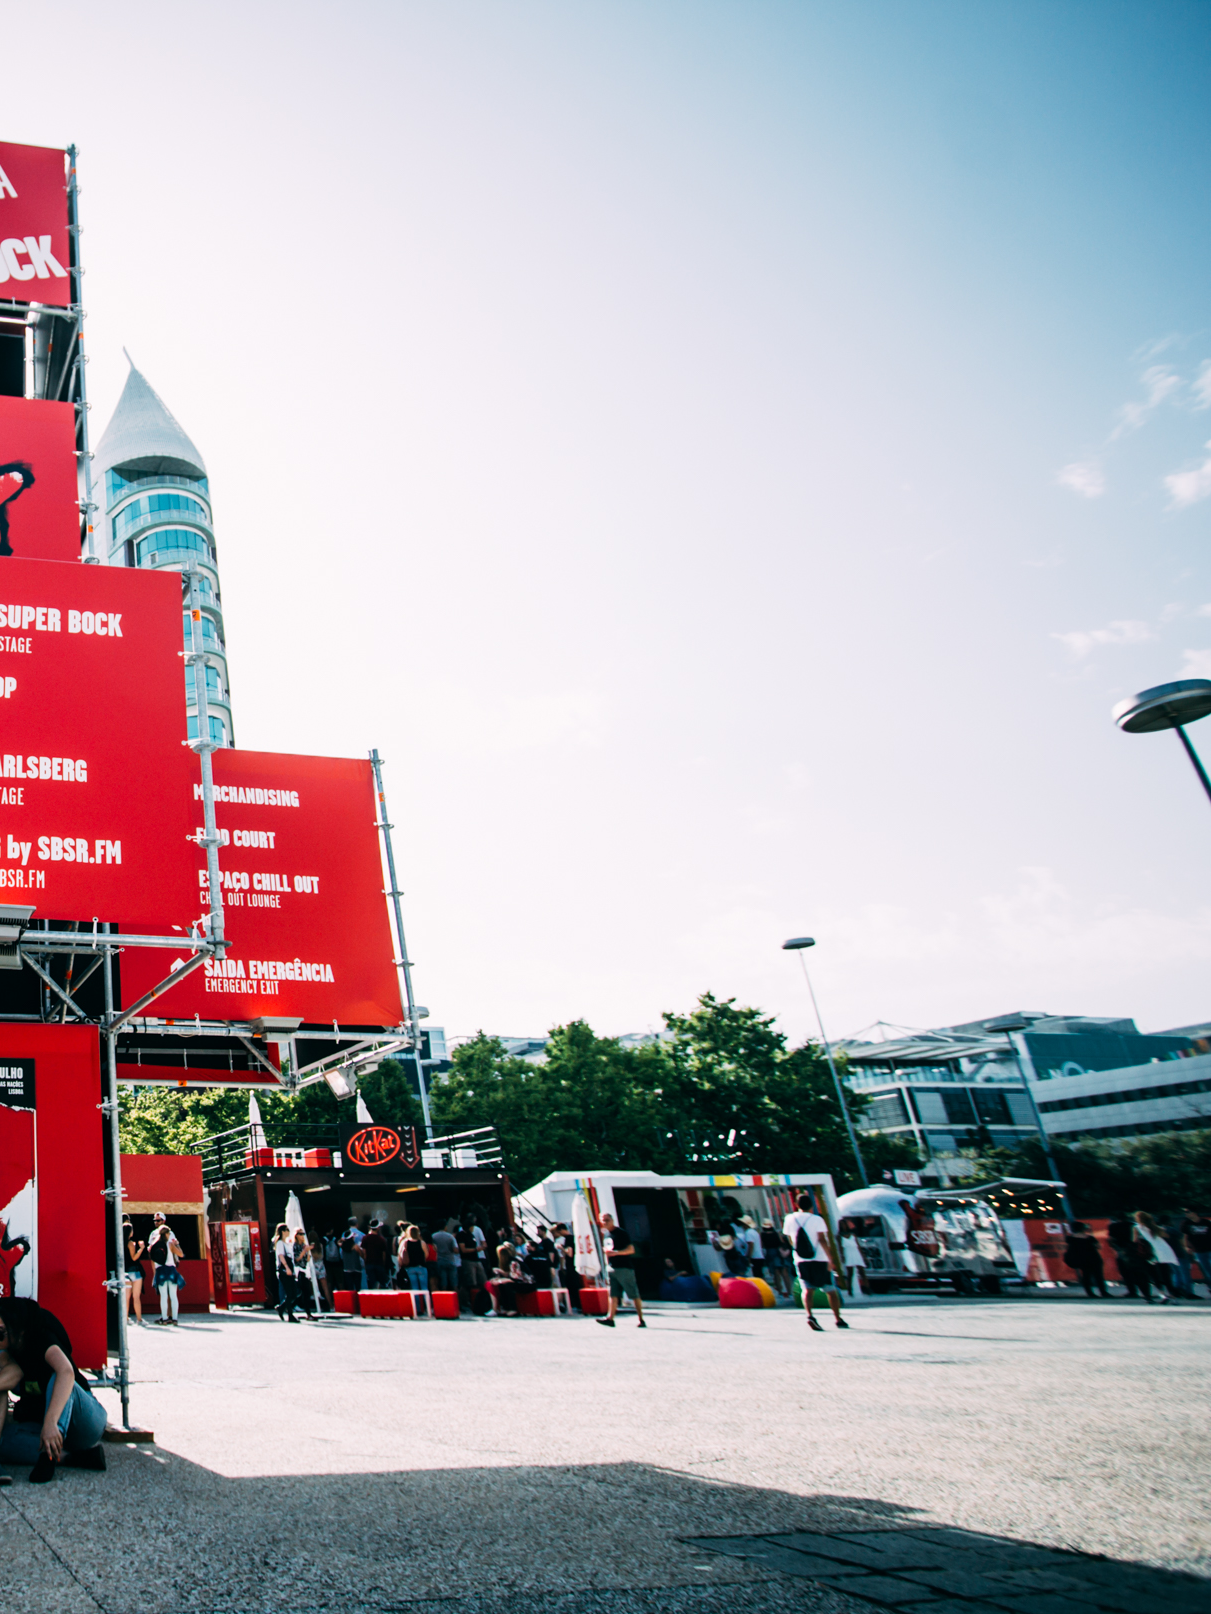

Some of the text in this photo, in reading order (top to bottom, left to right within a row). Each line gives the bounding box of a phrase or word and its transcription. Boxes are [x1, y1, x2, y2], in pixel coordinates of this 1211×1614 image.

[68, 609, 123, 637] BOCK
[193, 783, 300, 808] MRCHANDISING
[7, 835, 32, 866] by
[37, 836, 122, 865] SBSR.FM
[233, 829, 276, 849] COURT
[253, 873, 291, 893] CHILL
[294, 875, 320, 894] OUT
[227, 892, 245, 906] OUT
[247, 893, 281, 908] LOUNGE
[204, 956, 335, 983] SAÍDA EMERGÊNCIA
[205, 978, 279, 995] EMERGENCY EXIT
[355, 1130, 396, 1163] KitKat
